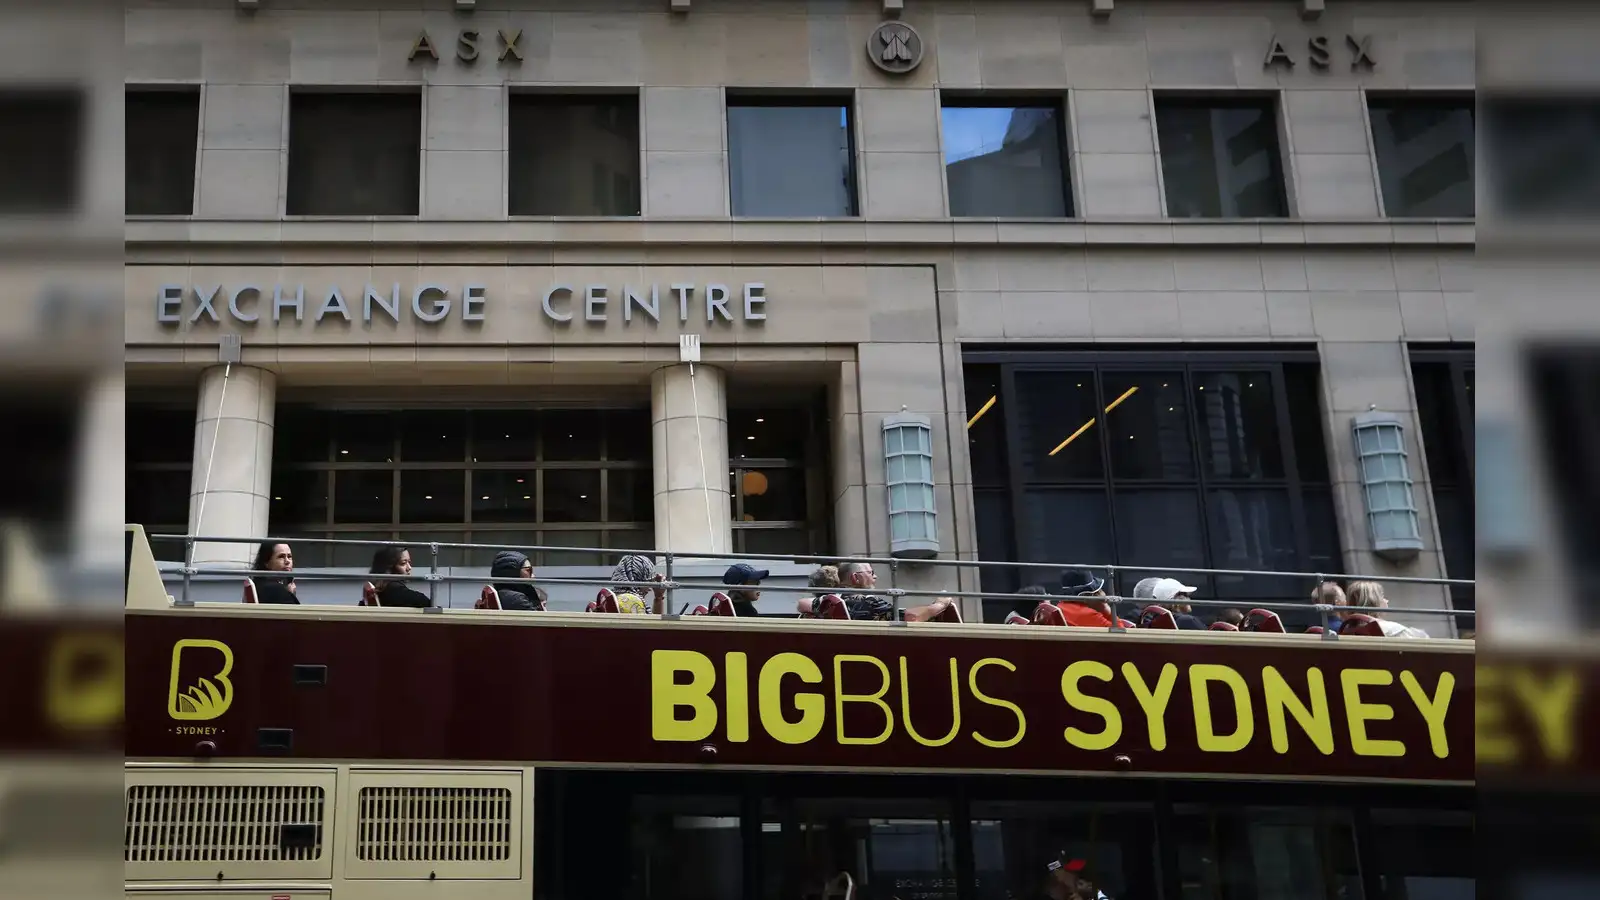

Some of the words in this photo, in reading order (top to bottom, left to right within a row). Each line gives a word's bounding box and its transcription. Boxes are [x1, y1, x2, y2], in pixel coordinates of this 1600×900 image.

[408, 28, 524, 62] ASX
[1264, 33, 1377, 69] ASX
[157, 283, 485, 323] EXCHANGE
[542, 283, 767, 323] CENTRE
[1061, 660, 1455, 758] SYDNEY
[175, 726, 218, 735] SYDNEY
